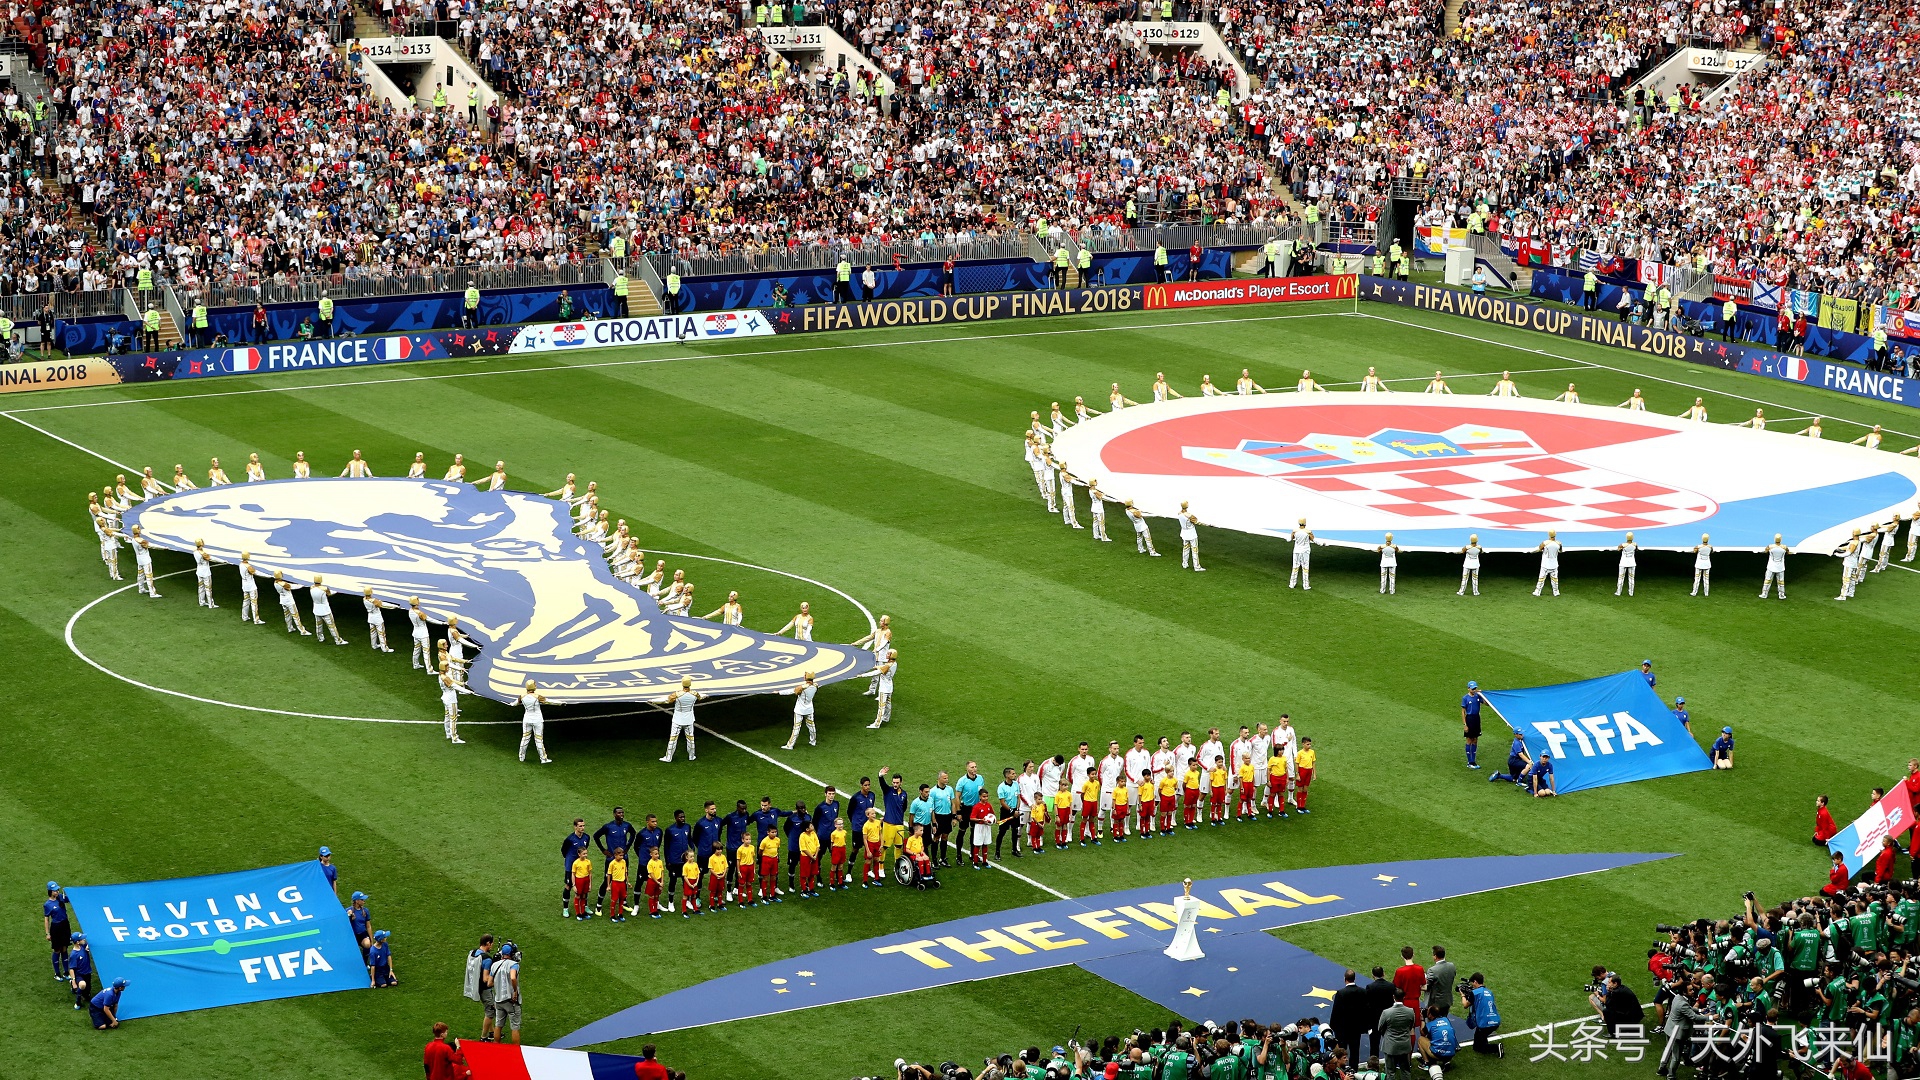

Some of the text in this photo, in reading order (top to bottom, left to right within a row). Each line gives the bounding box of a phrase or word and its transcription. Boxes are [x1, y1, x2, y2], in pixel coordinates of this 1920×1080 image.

[767, 34, 786, 44] 132
[802, 34, 821, 44] 131
[1142, 28, 1162, 38] 130
[1180, 29, 1199, 38] 129
[370, 45, 392, 56] 134
[410, 44, 430, 54] 133
[1701, 57, 1719, 66] 128
[1174, 281, 1330, 302] McDonald's Player Escort
[804, 305, 853, 331] FIFA
[859, 298, 947, 326] WORLD
[1012, 291, 1076, 316] FINAL
[1080, 288, 1131, 312] 2018
[594, 316, 698, 344] CROATIA
[1414, 285, 1454, 313] FIFA
[1458, 292, 1530, 327] WORLD
[1580, 317, 1636, 349] FINAL
[1640, 330, 1686, 358] 2018
[268, 339, 368, 369] FRANCE
[46, 364, 87, 382] 2018
[1824, 364, 1904, 401] FRANCE
[538, 655, 796, 689] WORLD CUP
[576, 659, 753, 682] FIFA
[1531, 711, 1664, 759] FIFA
[102, 886, 304, 923] LIVING
[873, 881, 1345, 970] THE FINAL
[1800, 930, 1818, 938] PHOTO
[239, 947, 333, 984] FIFA
[1217, 1058, 1235, 1066] PHOTO
